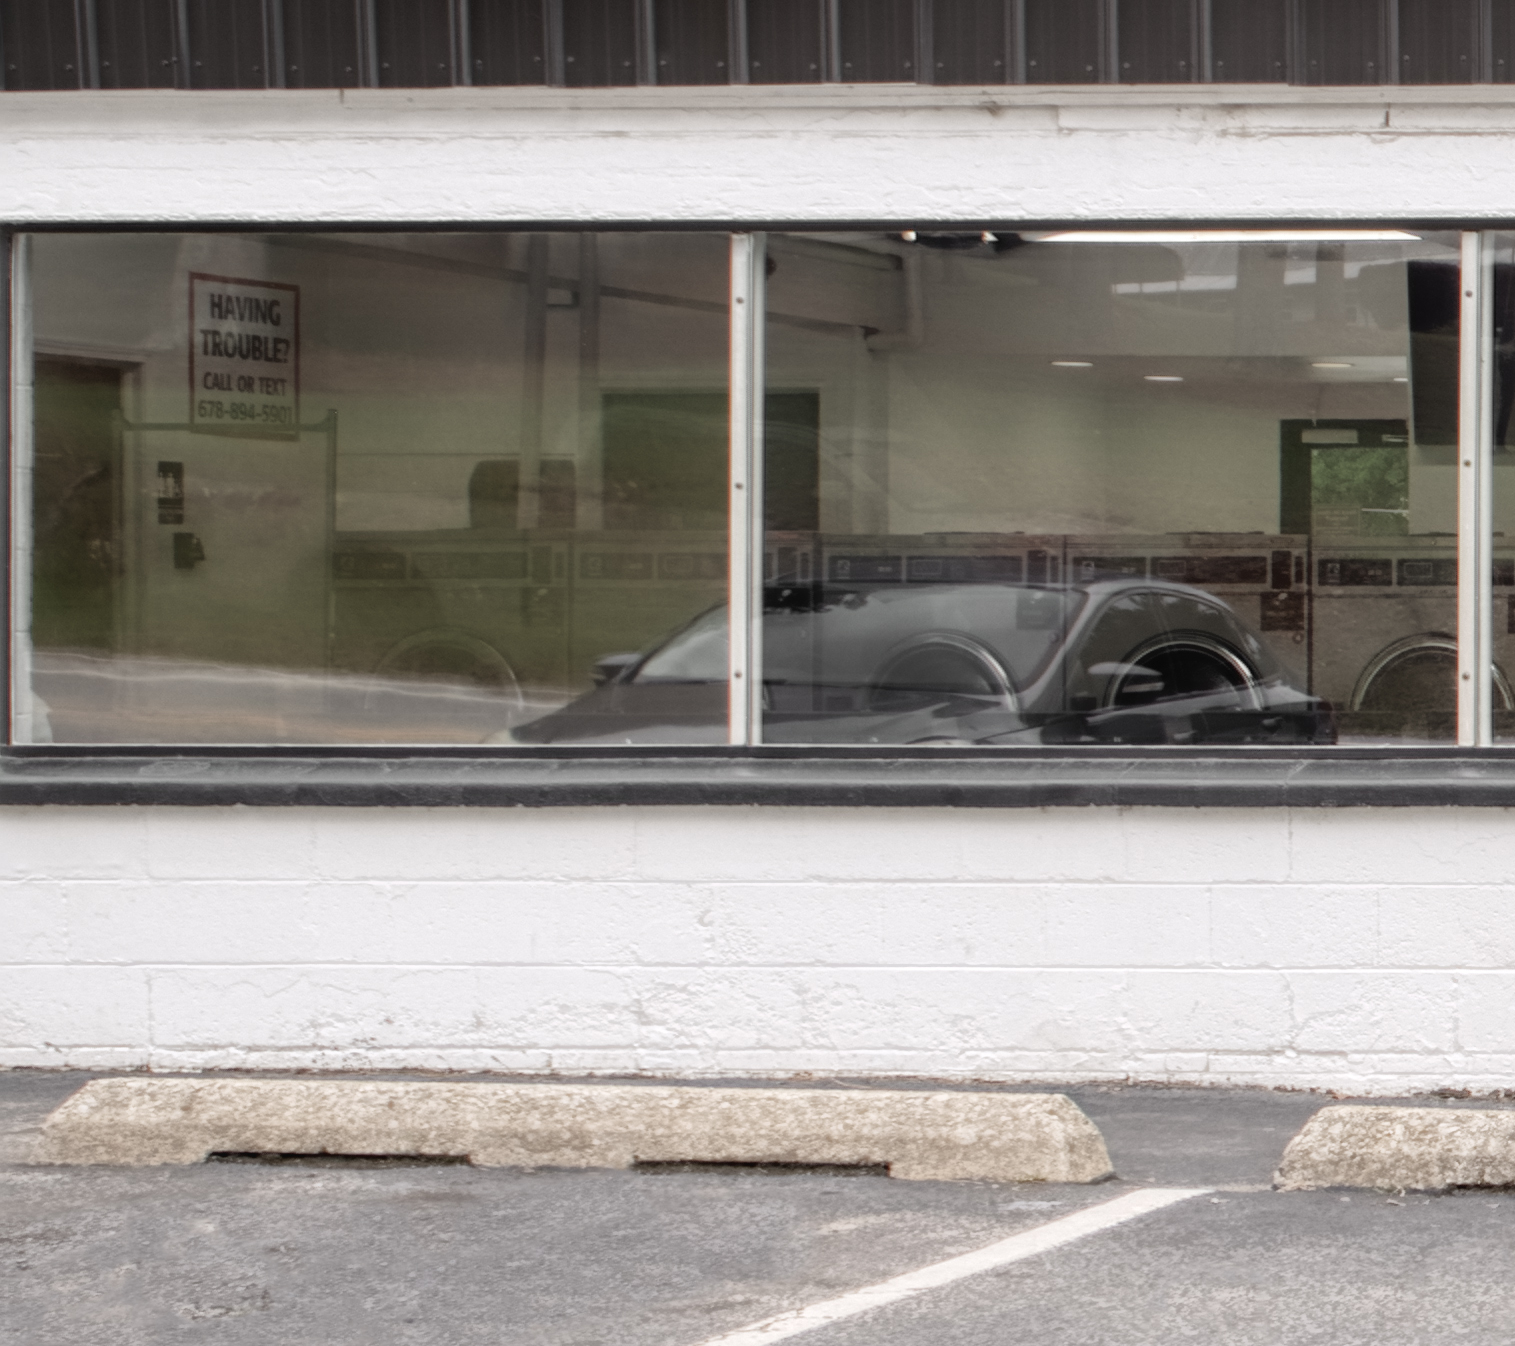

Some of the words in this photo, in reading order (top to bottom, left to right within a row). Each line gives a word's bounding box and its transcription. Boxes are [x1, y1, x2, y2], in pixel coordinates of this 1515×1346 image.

[210, 293, 281, 326] HAVING
[200, 329, 291, 363] TROUBLE?
[203, 371, 233, 391] CALL
[237, 375, 255, 393] OR
[258, 376, 287, 396] TEXT
[198, 399, 293, 423] 678-894-5901
